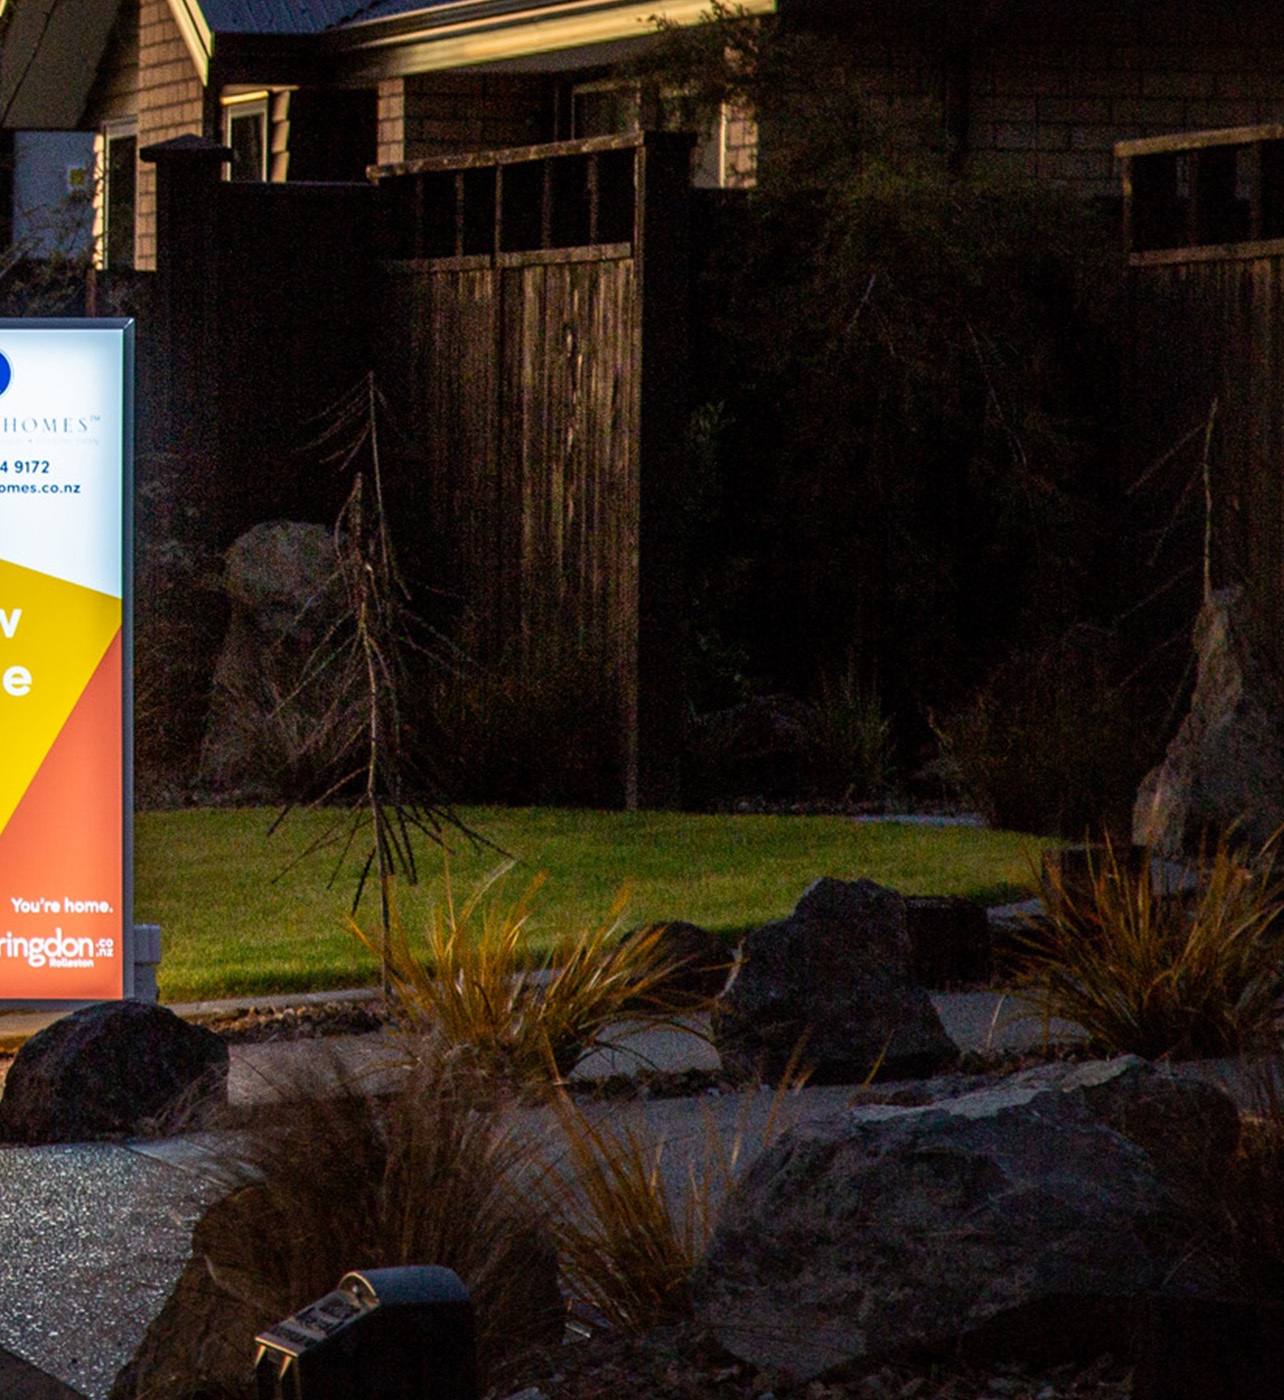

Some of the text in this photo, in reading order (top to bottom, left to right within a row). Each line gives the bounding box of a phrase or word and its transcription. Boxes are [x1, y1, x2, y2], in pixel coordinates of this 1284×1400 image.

[14, 460, 50, 474] 9172
[11, 896, 113, 914] You're home.
